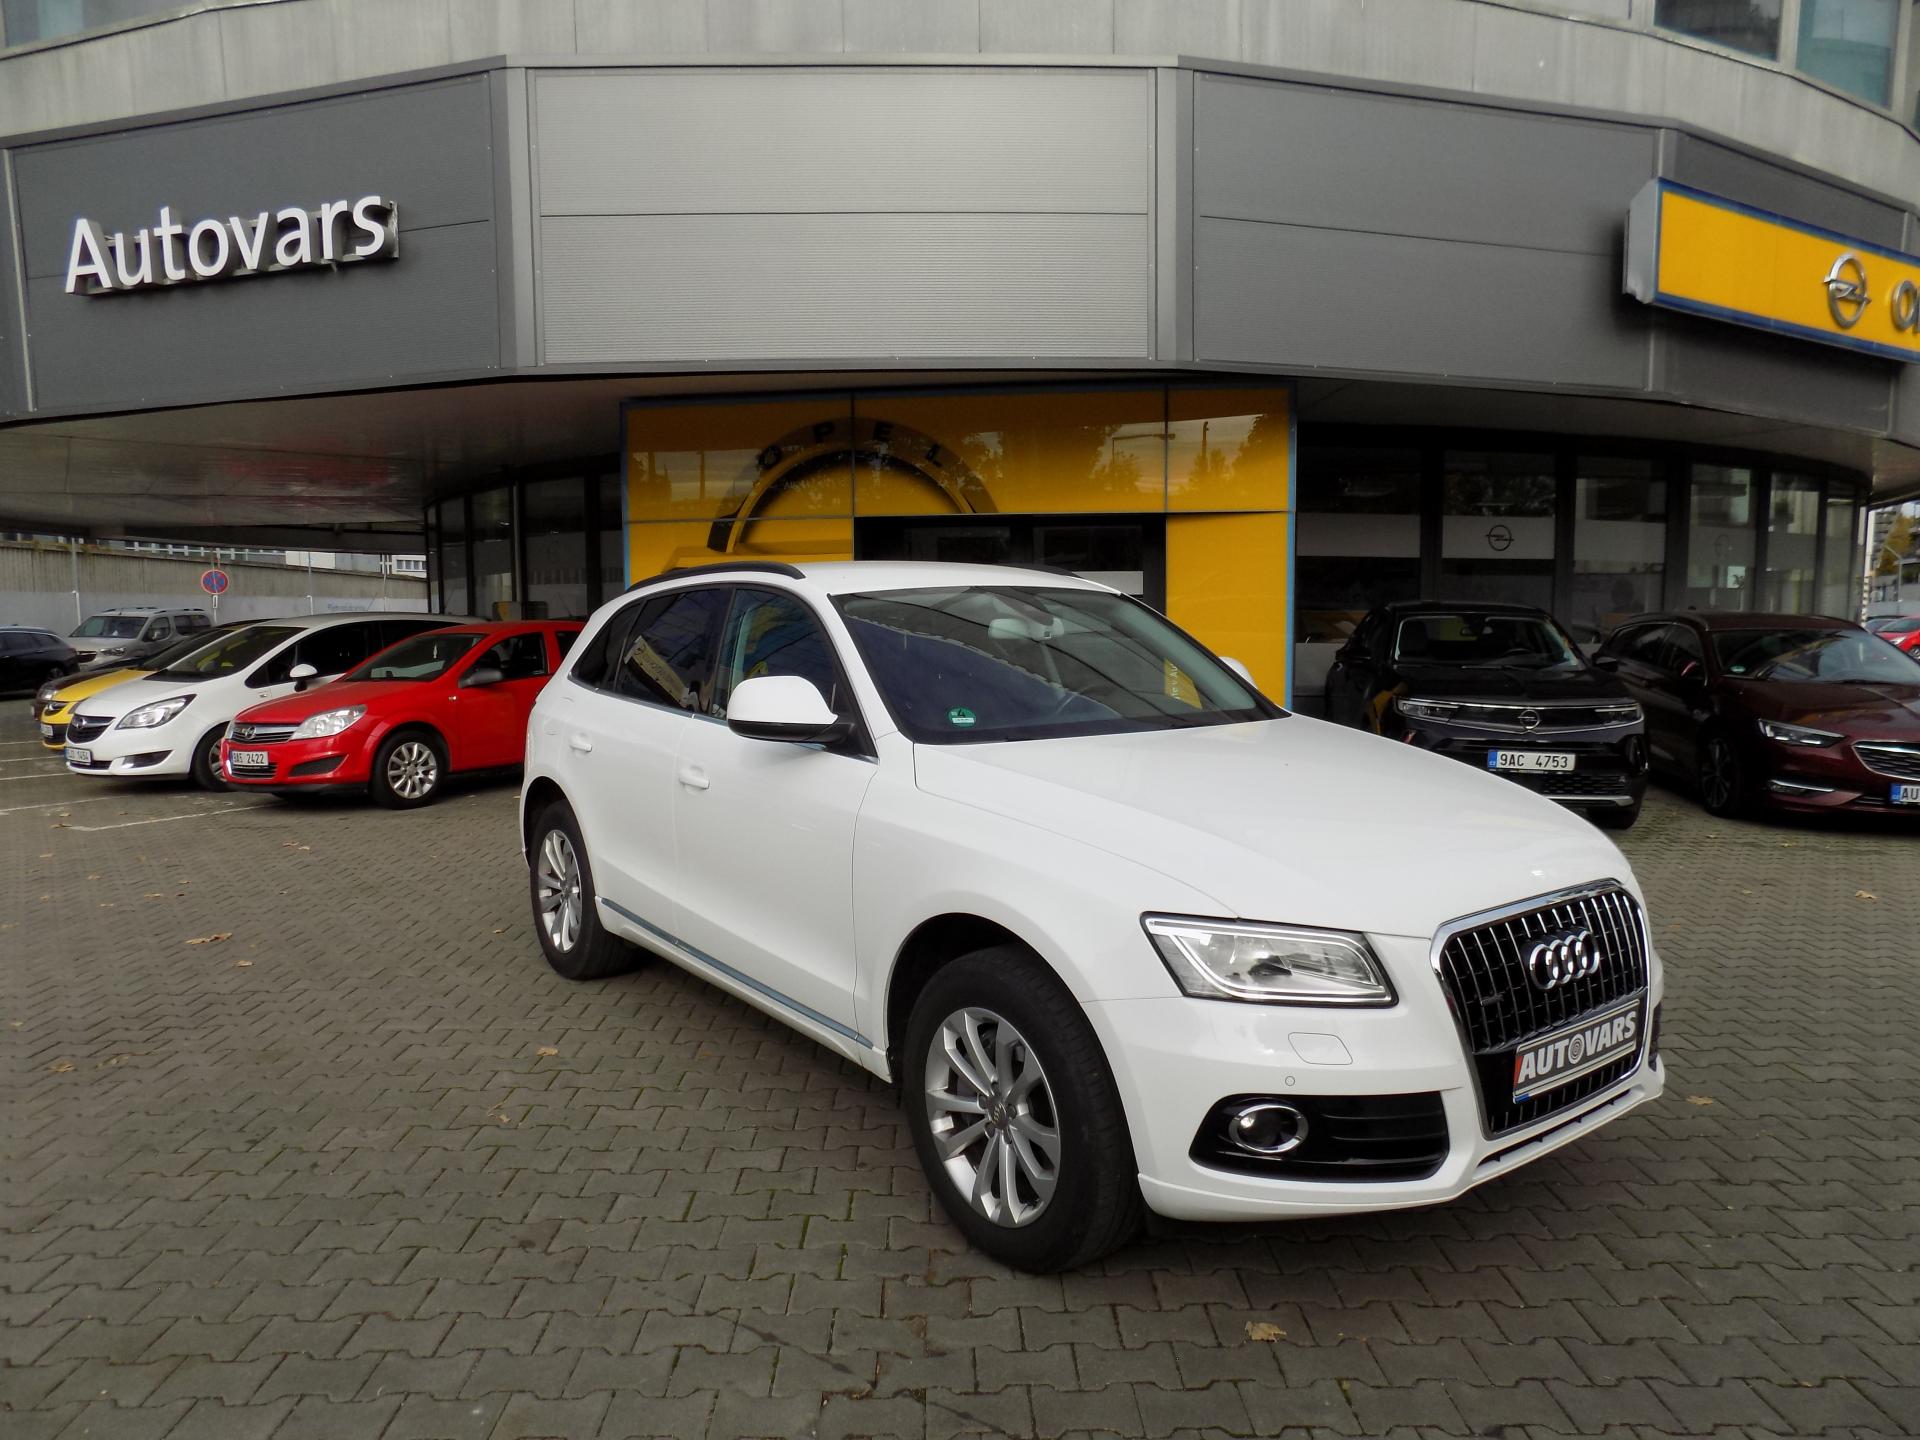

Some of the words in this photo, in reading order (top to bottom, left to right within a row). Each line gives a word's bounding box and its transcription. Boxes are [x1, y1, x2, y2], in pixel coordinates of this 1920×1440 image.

[65, 195, 386, 293] Autovars
[756, 421, 943, 469] OPEL
[246, 753, 264, 764] 2422
[1500, 753, 1525, 767] 9AC
[1535, 755, 1569, 769] 4753
[1902, 787, 1919, 800] AU
[1518, 1010, 1637, 1083] AUTOVARS
